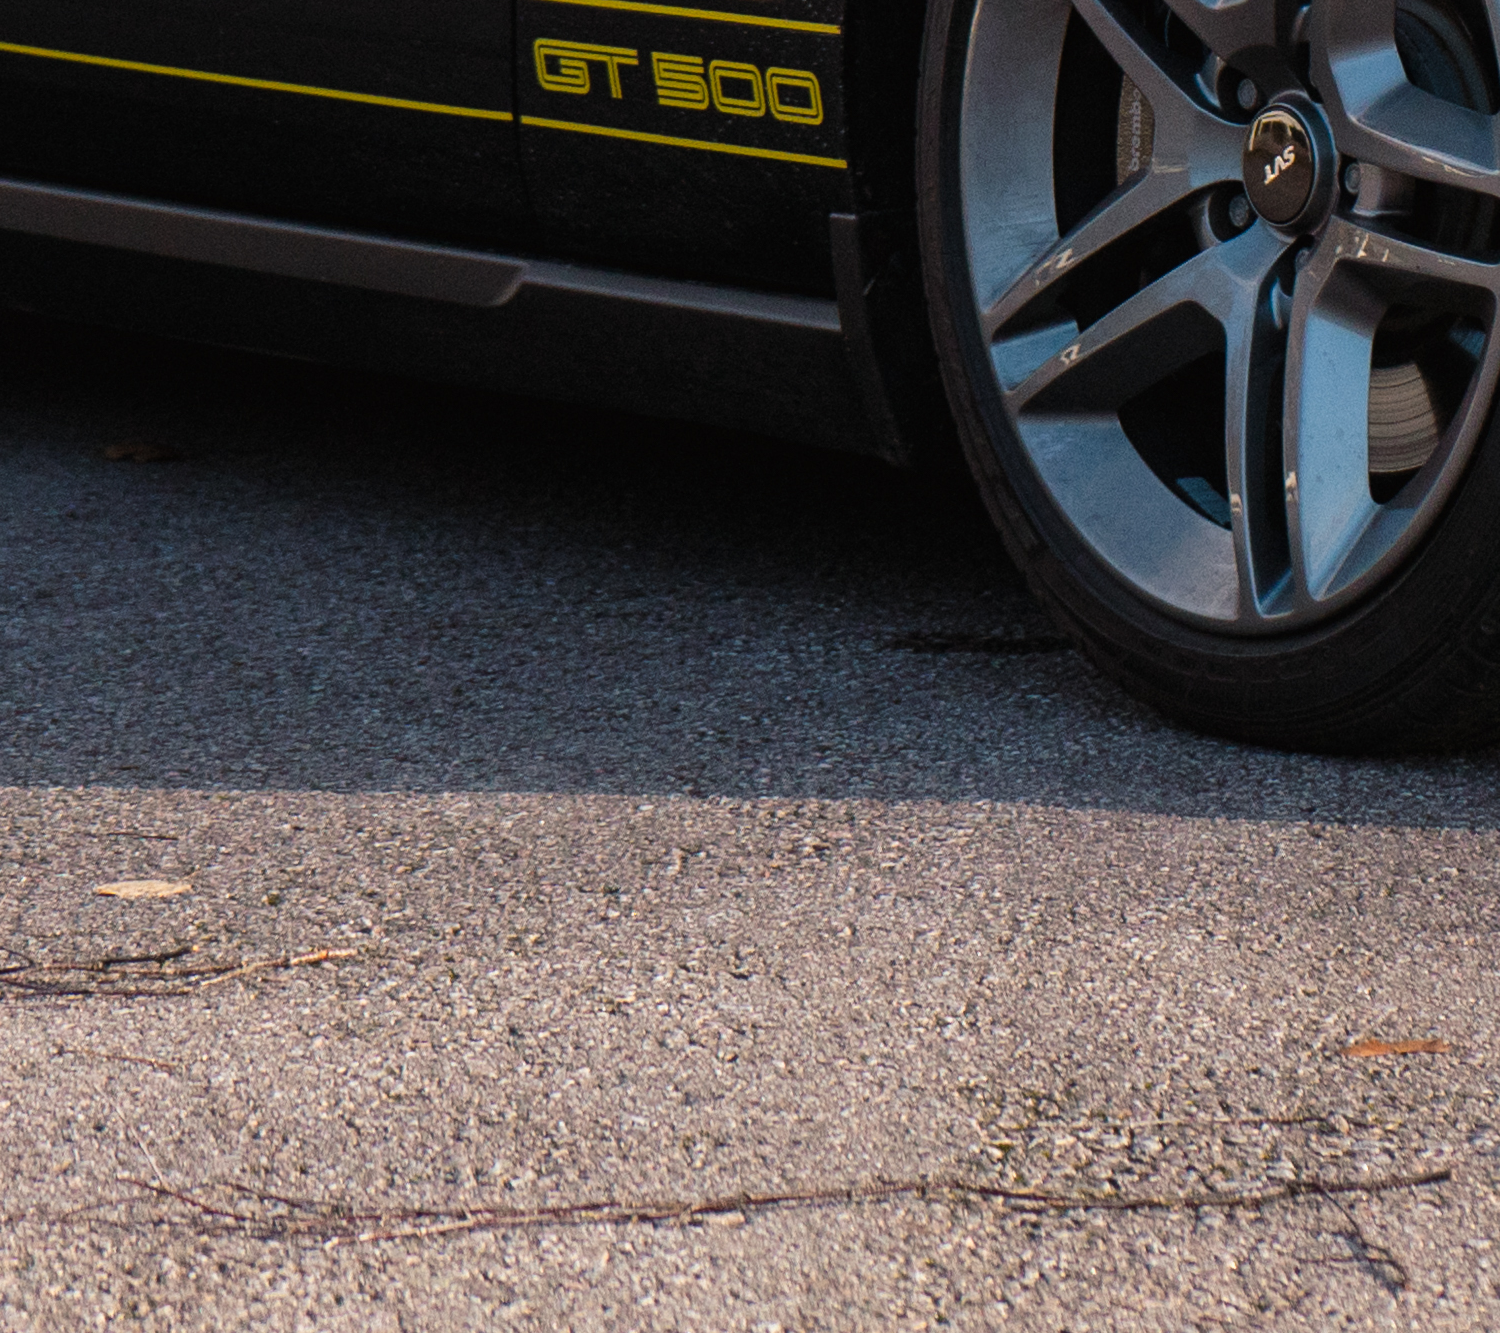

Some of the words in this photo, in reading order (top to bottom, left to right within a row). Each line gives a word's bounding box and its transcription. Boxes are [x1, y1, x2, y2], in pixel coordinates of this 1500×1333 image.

[534, 38, 639, 99] GT
[651, 52, 824, 126] 500
[1262, 144, 1297, 186] SVT
